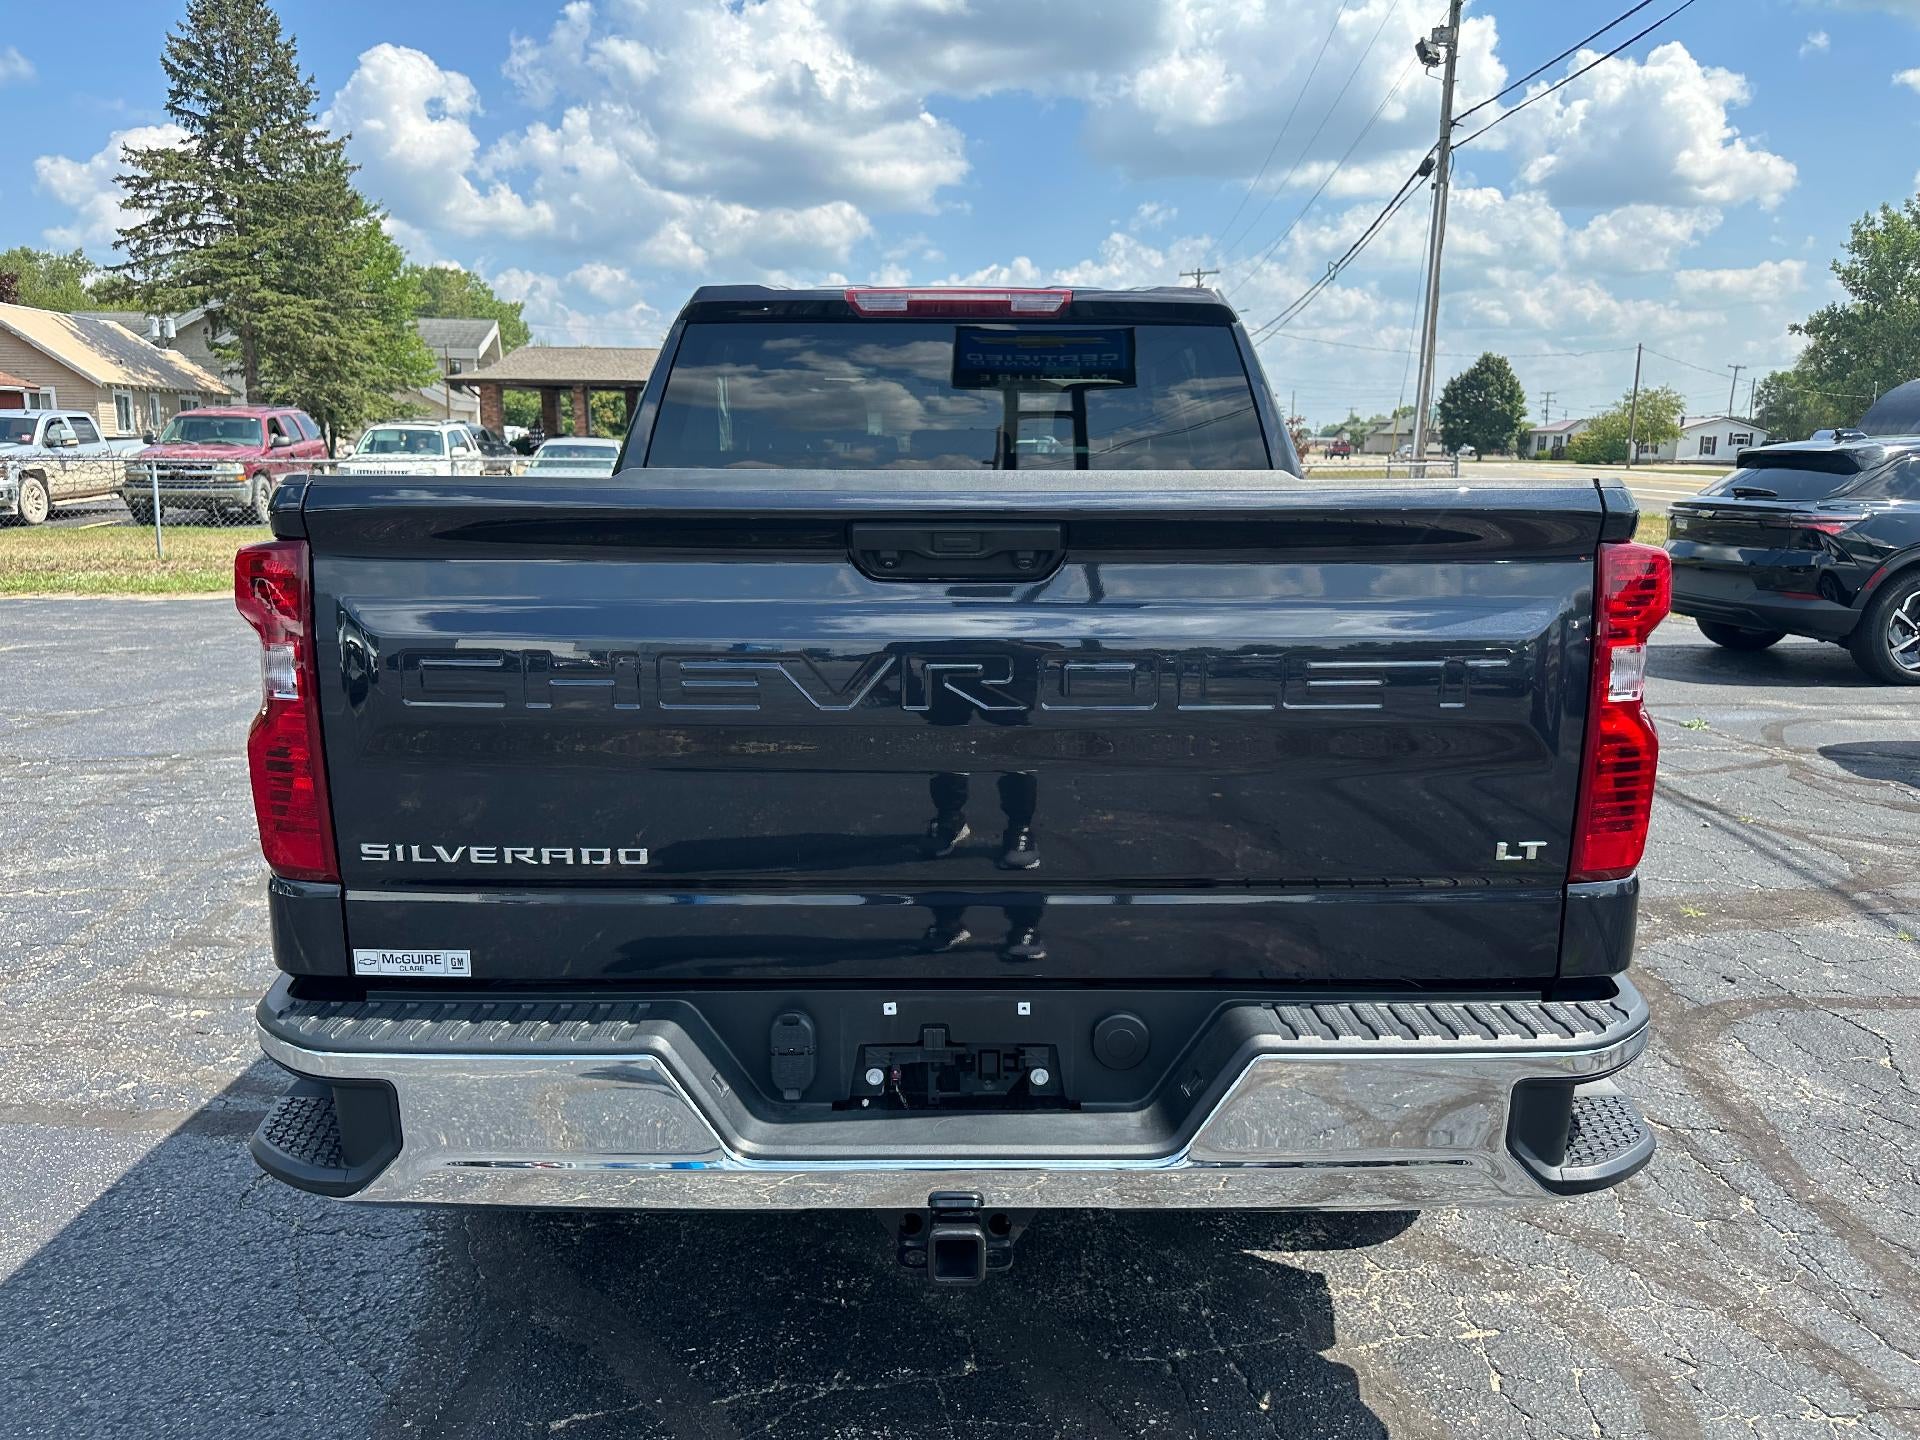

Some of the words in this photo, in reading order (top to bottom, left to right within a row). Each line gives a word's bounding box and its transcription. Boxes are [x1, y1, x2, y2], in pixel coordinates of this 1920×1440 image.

[400, 648, 1516, 711] CHEVROLET
[360, 843, 649, 865] SILVERADO
[1496, 841, 1548, 861] LT
[382, 953, 442, 965] McGUIRE
[450, 957, 464, 967] GM
